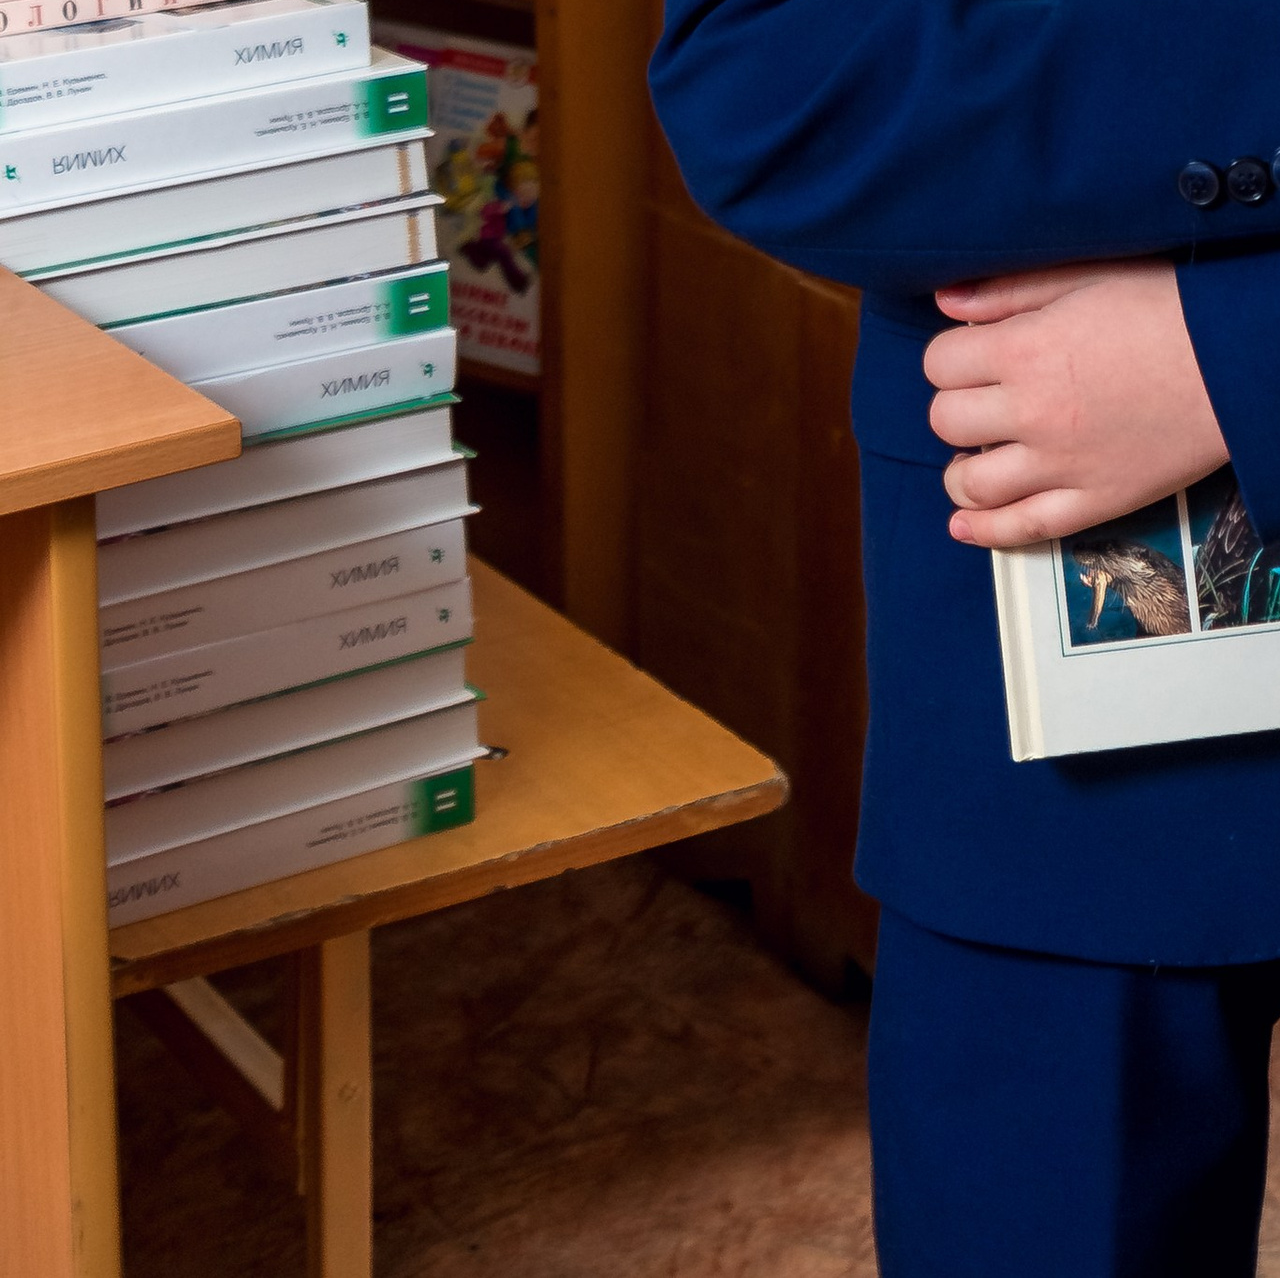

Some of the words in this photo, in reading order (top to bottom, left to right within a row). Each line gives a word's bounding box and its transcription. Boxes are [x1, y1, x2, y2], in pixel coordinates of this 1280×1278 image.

[234, 37, 304, 66] ХИМИЯ
[52, 144, 128, 175] ХИМИЯ
[320, 368, 391, 399] ХИМИЯ
[330, 555, 400, 590] ХИМИЯ
[338, 616, 408, 651] ХИМИЯ
